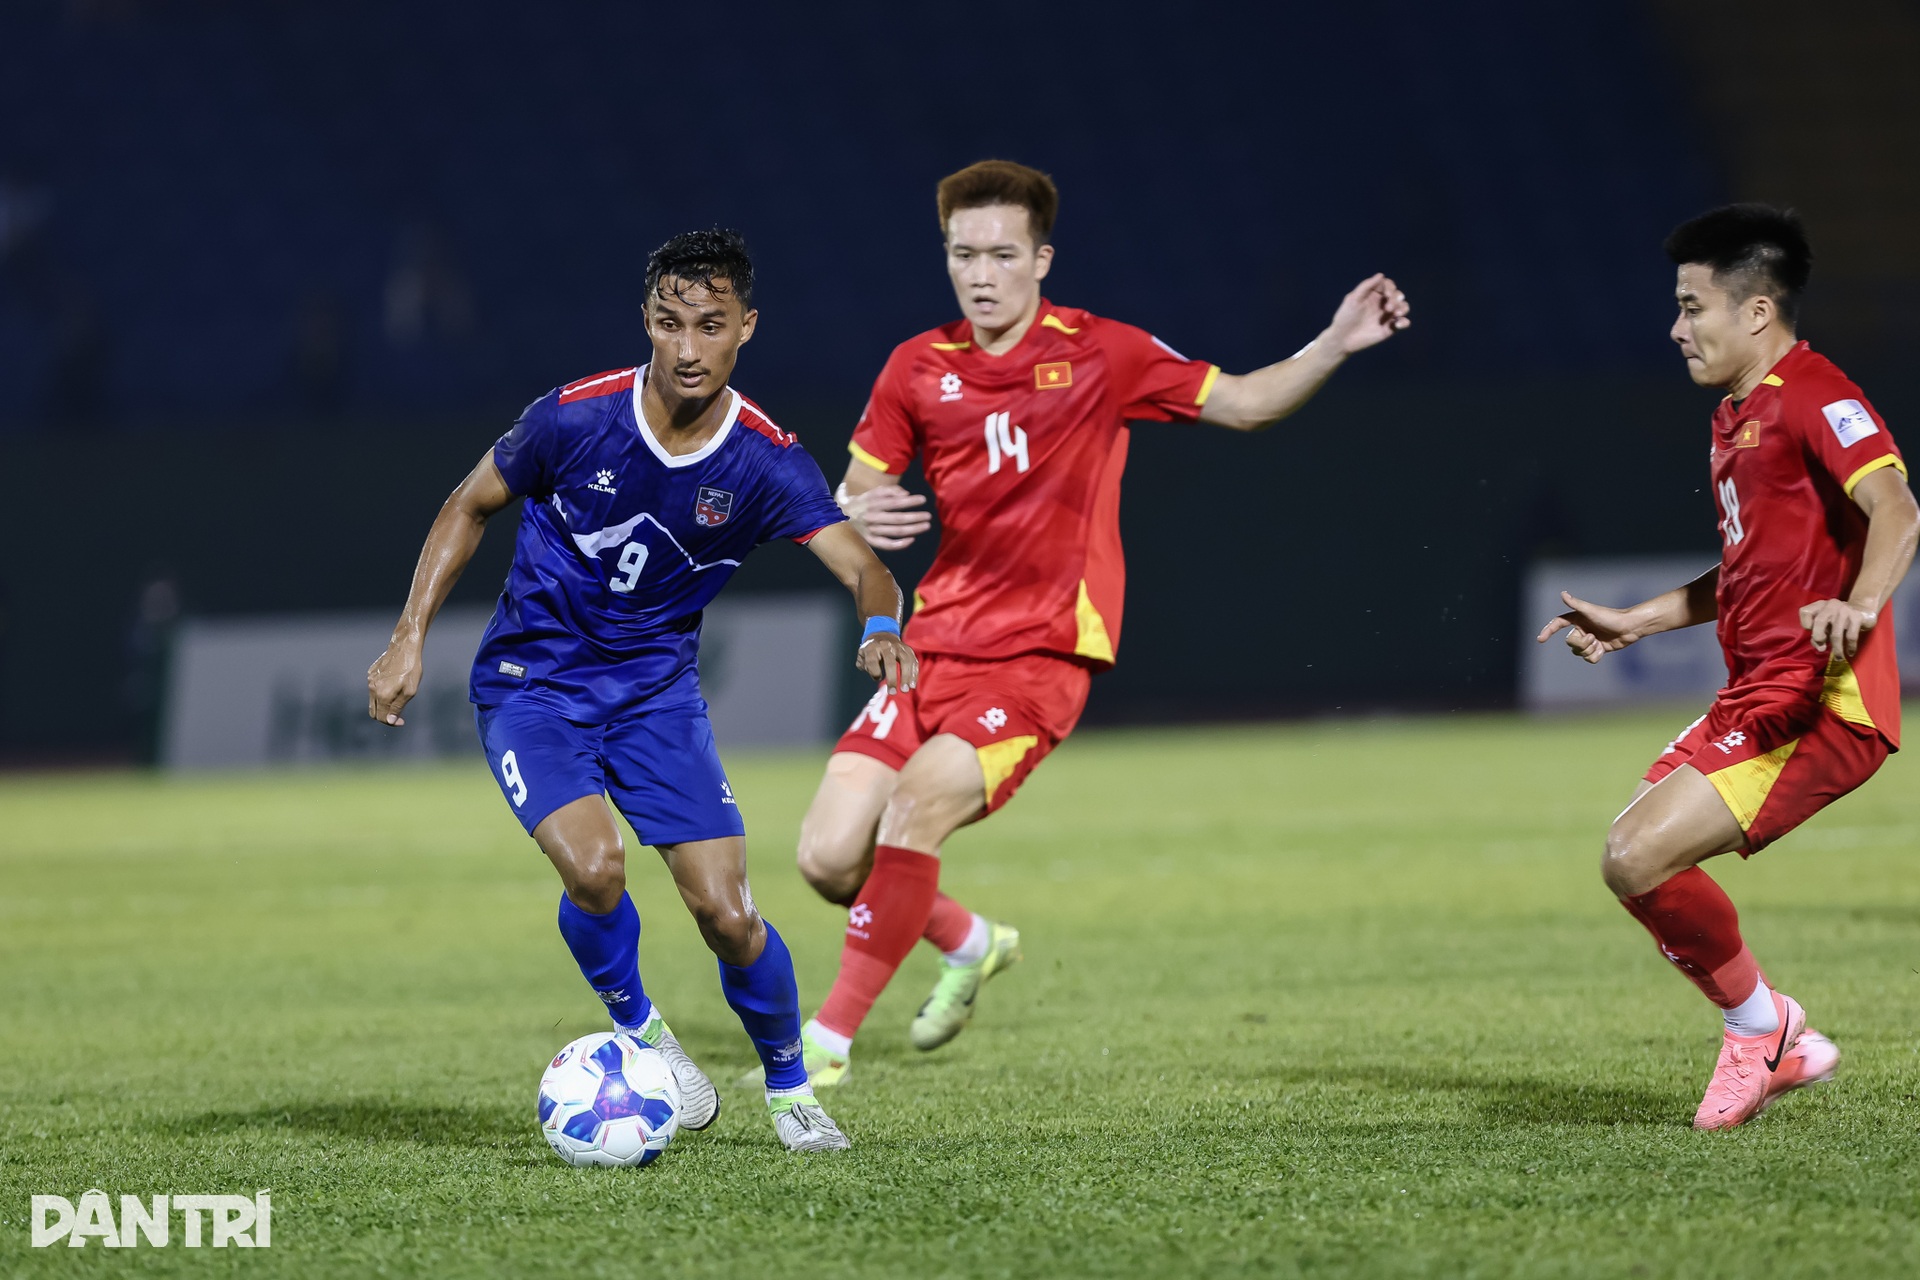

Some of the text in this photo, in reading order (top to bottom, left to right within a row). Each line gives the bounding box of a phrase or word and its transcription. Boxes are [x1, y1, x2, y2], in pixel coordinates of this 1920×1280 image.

[985, 411, 1030, 474] 14
[588, 483, 617, 495] KELME
[708, 490, 724, 499] NEPAL
[609, 541, 649, 593] 9
[501, 749, 528, 807] 9
